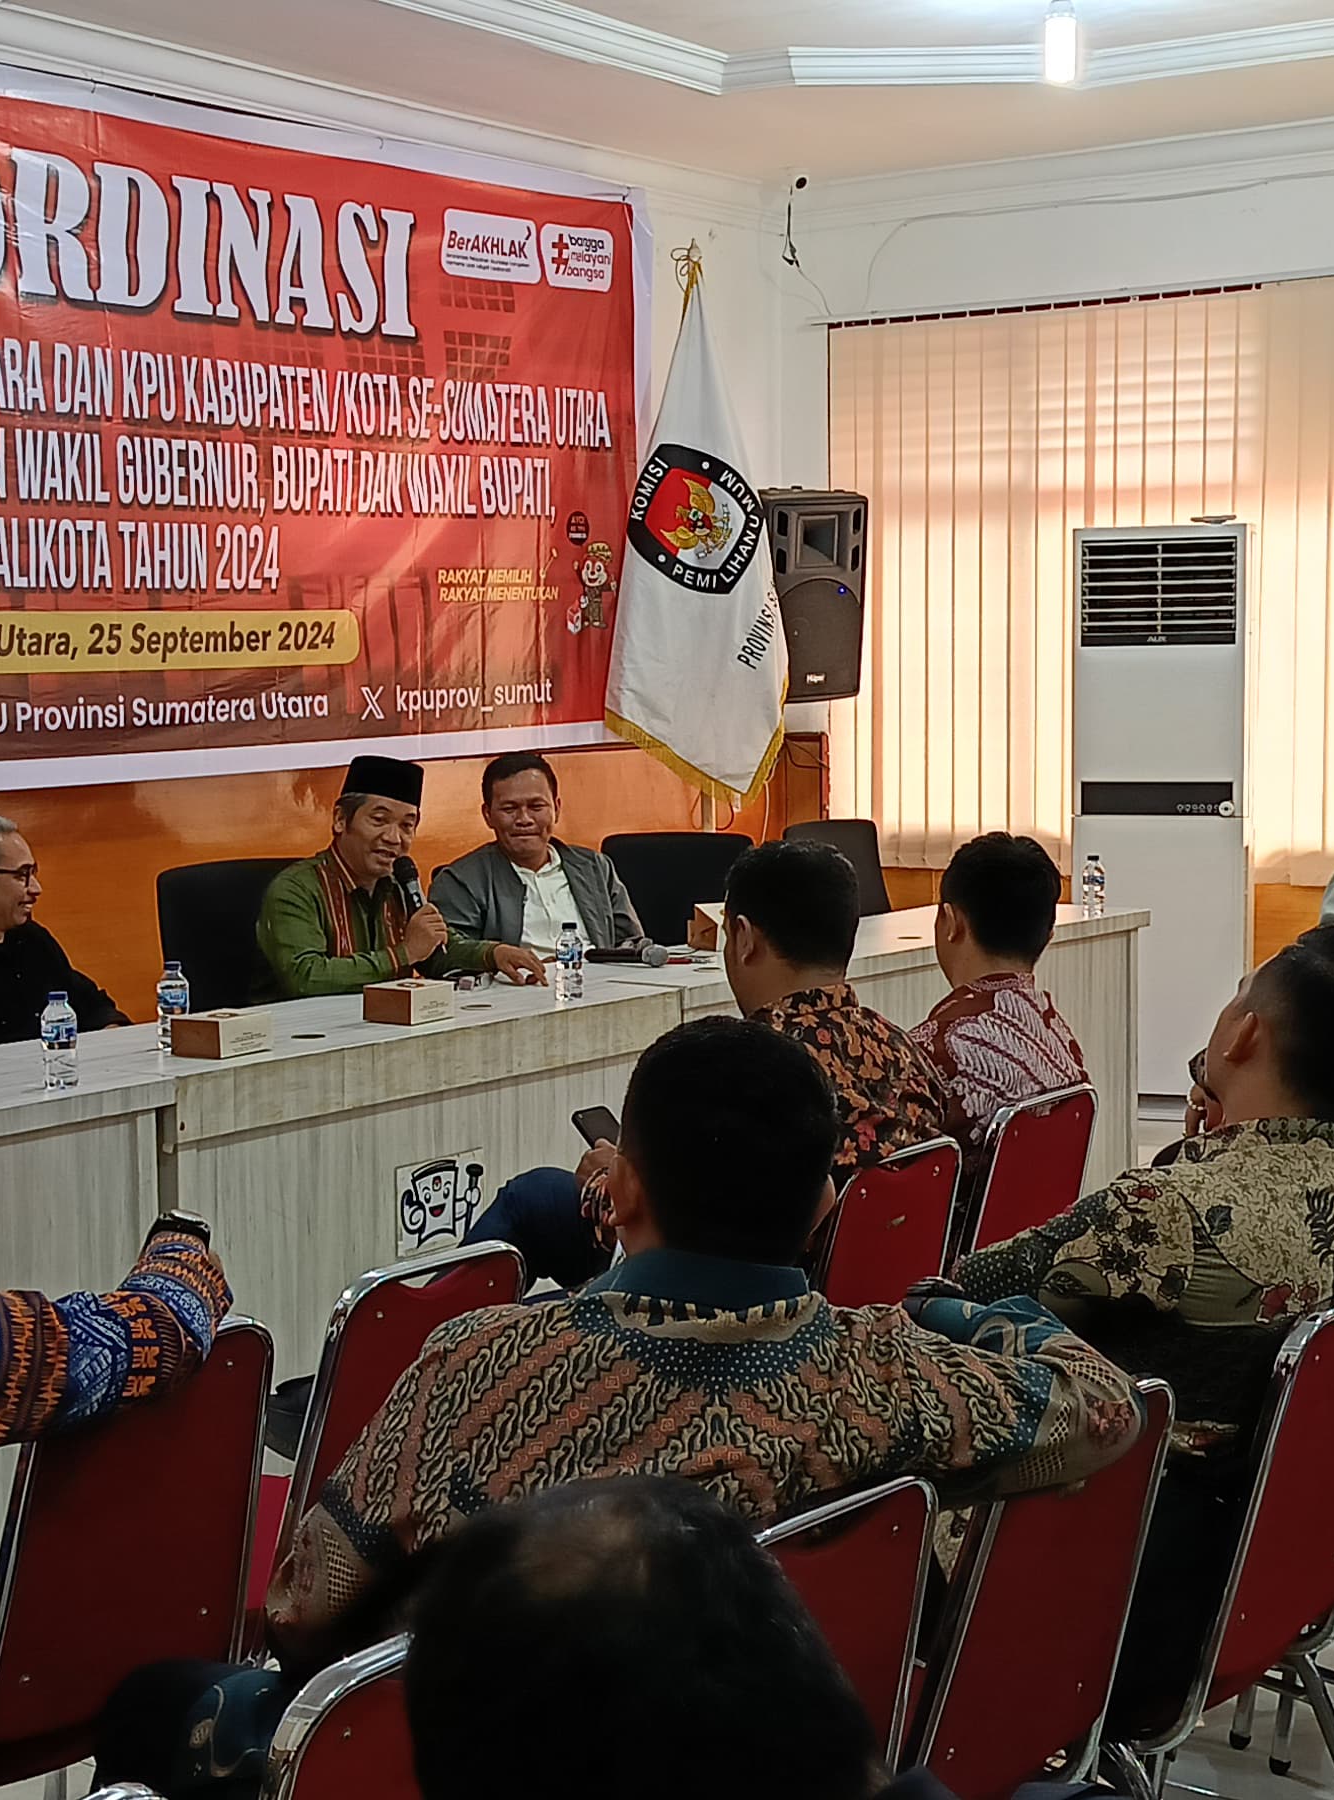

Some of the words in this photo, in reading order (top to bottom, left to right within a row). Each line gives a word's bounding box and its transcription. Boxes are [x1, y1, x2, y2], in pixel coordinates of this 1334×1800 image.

[447, 230, 528, 259] BerAKHLAK
[568, 234, 605, 253] bangga
[566, 264, 605, 281] bangsa
[54, 343, 115, 419] DAN
[122, 349, 175, 422] KPU
[183, 356, 403, 439] KABUPATEN/KOTA
[407, 375, 551, 443] SE-SUMATERA
[554, 386, 611, 449] UTARA
[15, 428, 110, 503] WAKIL
[116, 437, 265, 517] GUBERNUR,
[273, 447, 356, 512] BUPATI
[357, 450, 403, 514] DAN
[480, 456, 556, 524] BUPATI,
[631, 456, 669, 521] KOMISI
[672, 530, 757, 589] PEMILIHAN
[719, 470, 760, 529] UMUM
[118, 521, 207, 590] TAHUN
[215, 526, 280, 591] 2024
[438, 569, 486, 584] RAKYAT
[487, 569, 532, 583] MEMILIH
[439, 587, 486, 602] RAKYAT
[486, 586, 559, 600] MENENTUKAN
[86, 624, 124, 656] 25
[129, 621, 272, 662] September
[278, 622, 336, 652] 2024
[737, 603, 776, 670] PROVINSI
[16, 695, 125, 731] Provinsi
[132, 692, 255, 726] Sumatera
[261, 690, 328, 719] Utara
[395, 677, 552, 715] kpuprov_sumut
